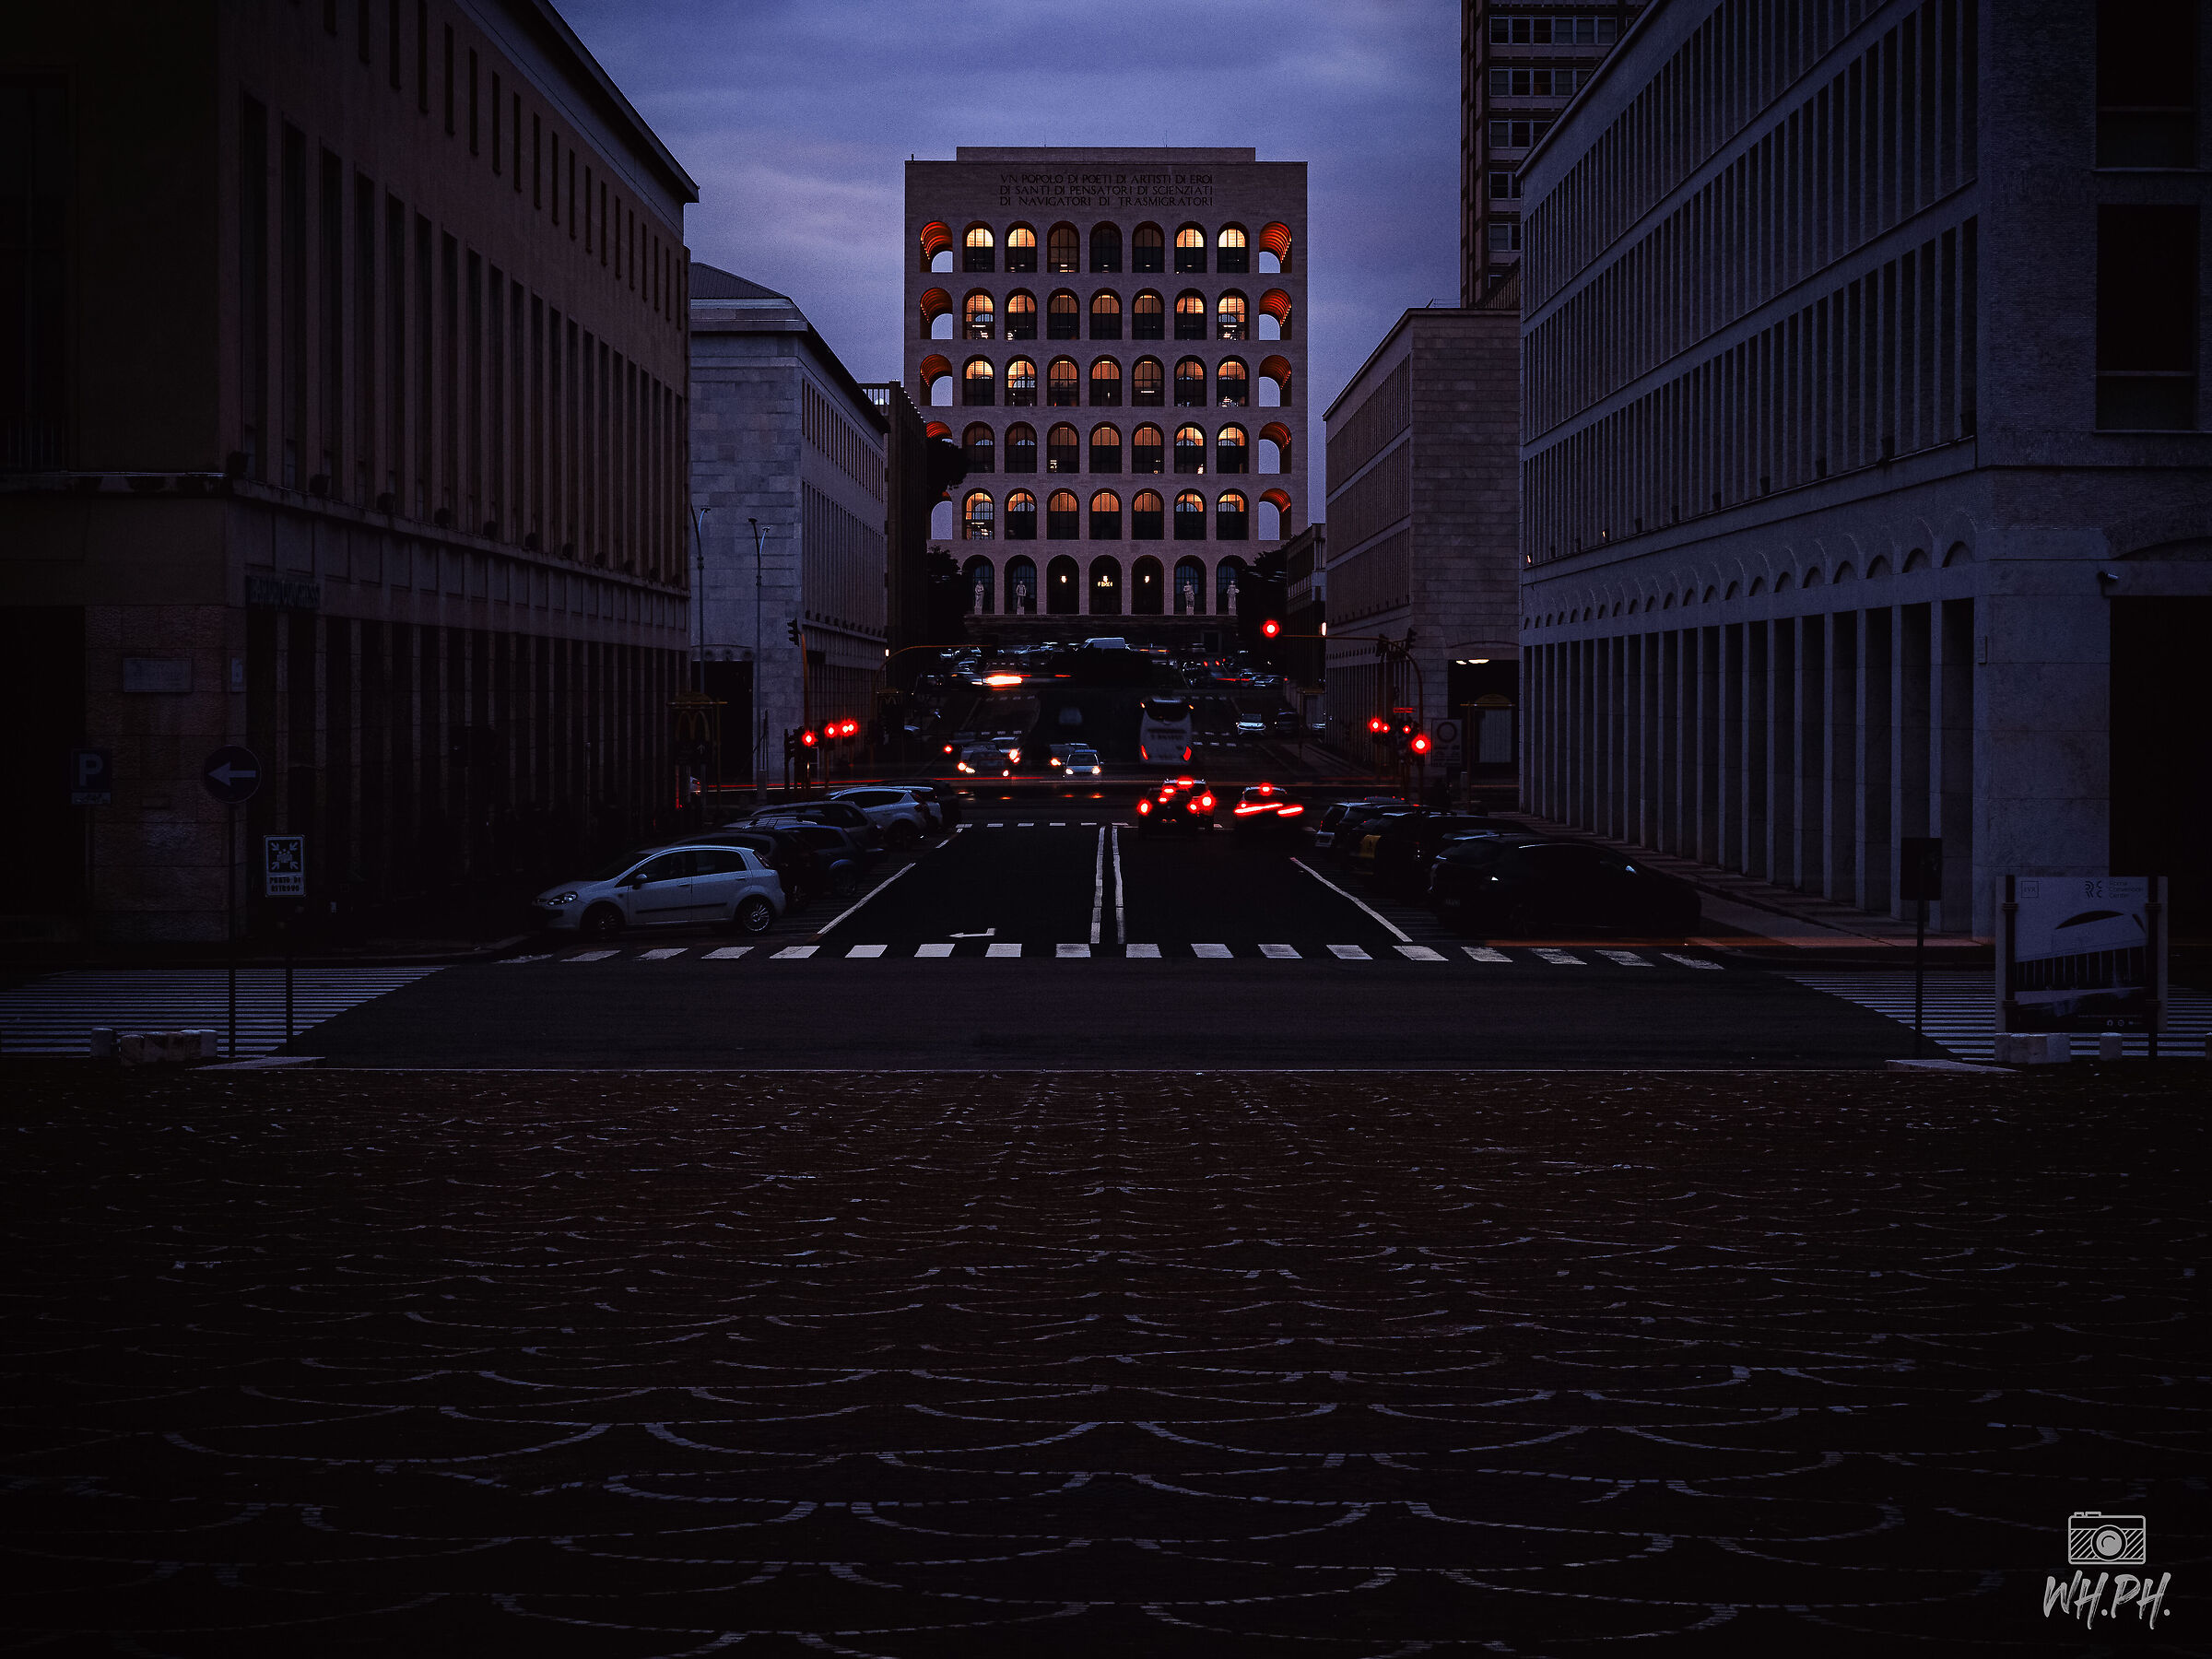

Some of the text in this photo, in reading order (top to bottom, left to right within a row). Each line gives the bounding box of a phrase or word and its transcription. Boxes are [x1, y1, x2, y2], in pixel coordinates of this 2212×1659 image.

[1022, 174, 1064, 183] POPOLO
[1068, 174, 1078, 183] DI
[1083, 174, 1112, 183] POETI
[1117, 174, 1126, 183] DI
[1131, 174, 1171, 183] ARTISTI
[1176, 174, 1186, 183] DI
[1190, 174, 1213, 183] EROI
[1000, 185, 1213, 194] DI SANTI DI PENSATORI DI SCIENZIATI
[1000, 196, 1213, 206] DI NAVIGATORI DI TRASMIGRATORI
[78, 752, 104, 787] P
[271, 884, 300, 892] RITROVO
